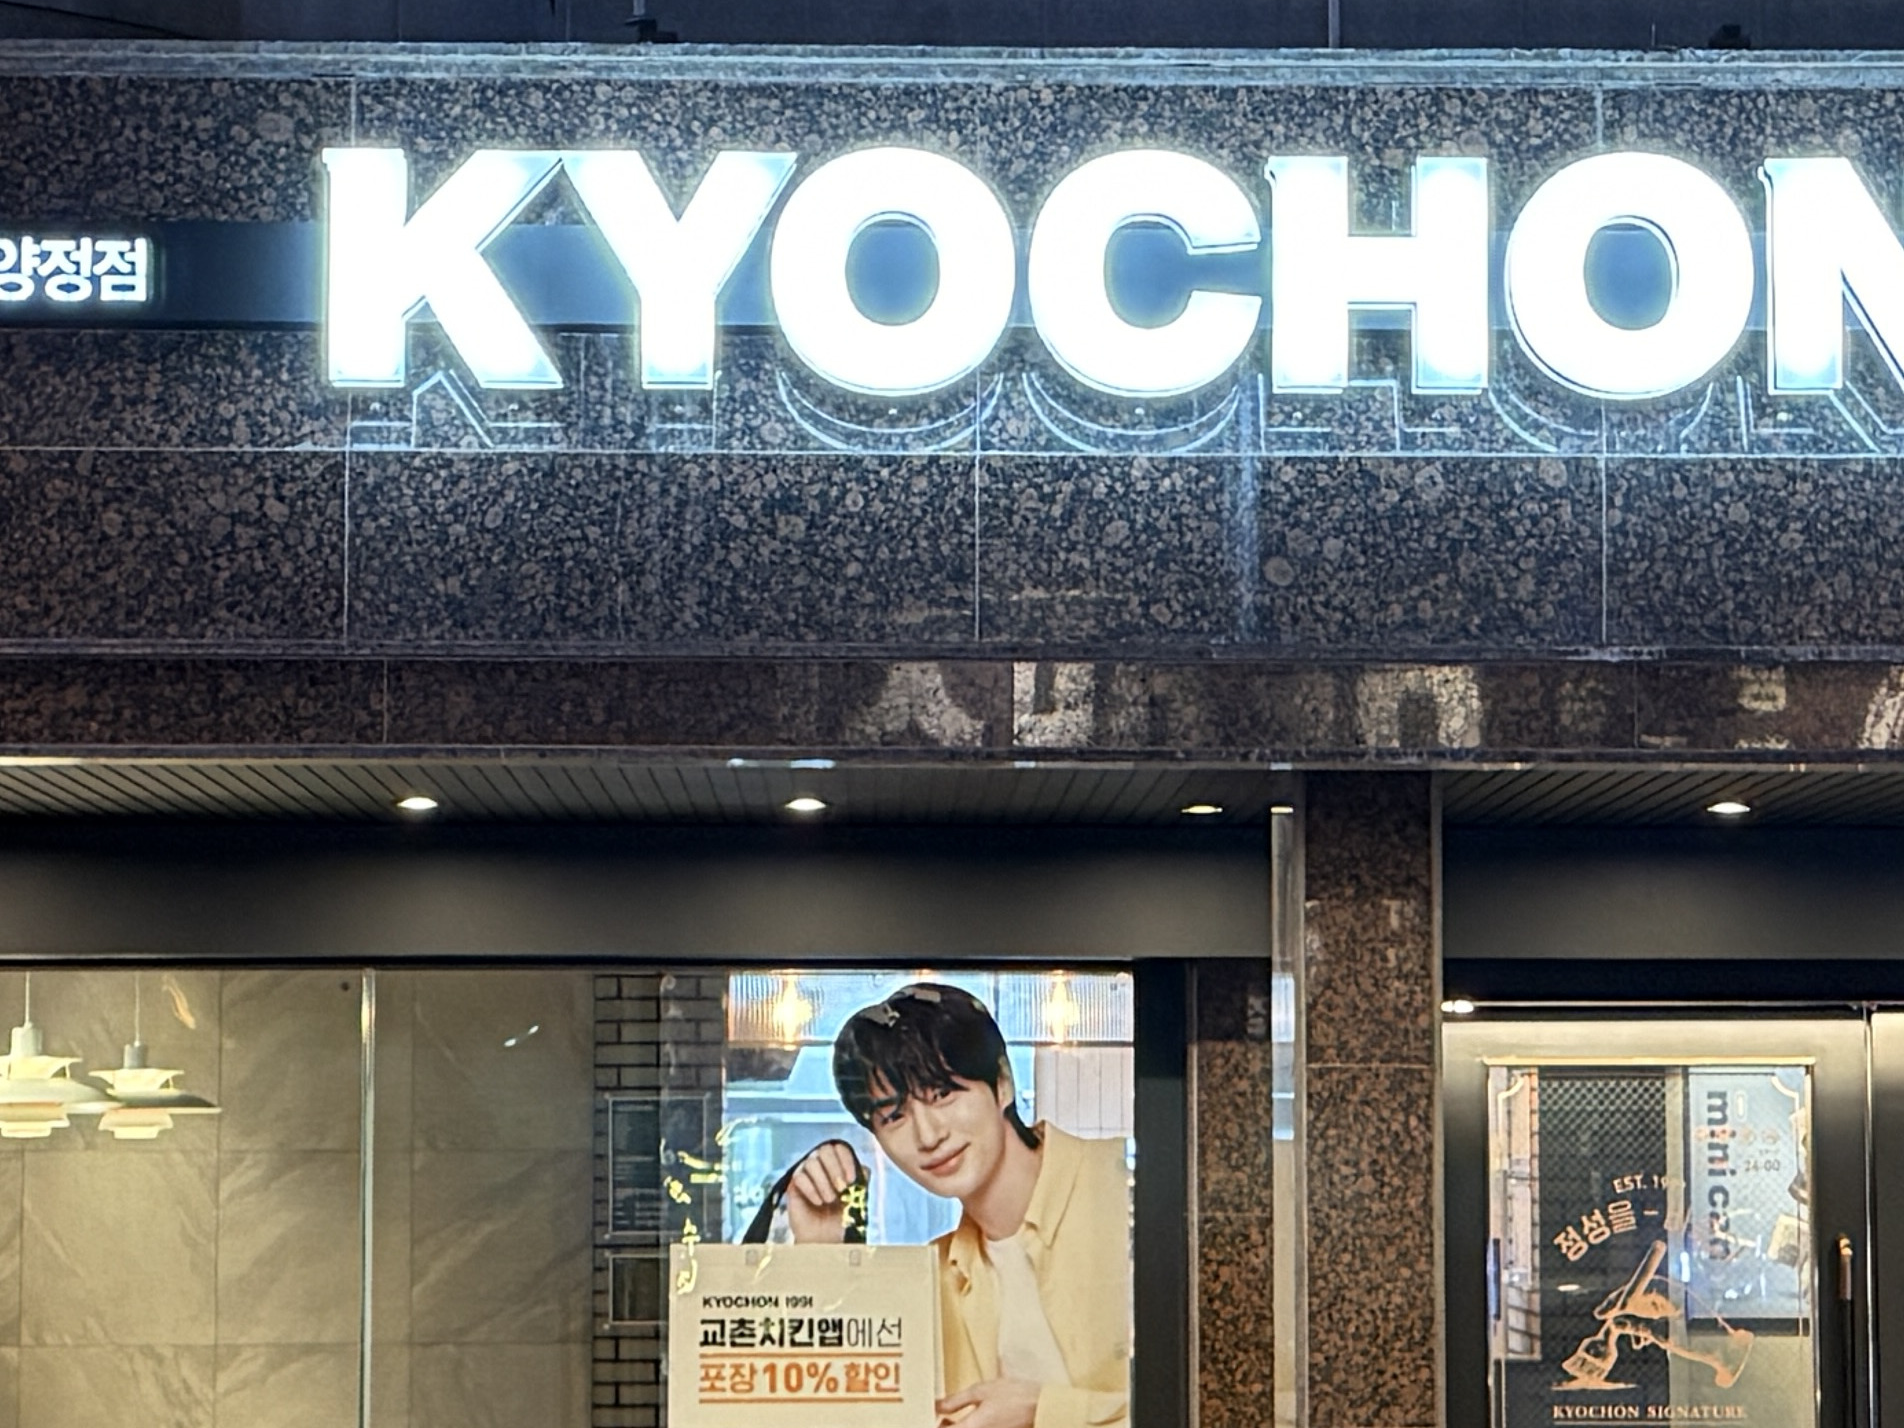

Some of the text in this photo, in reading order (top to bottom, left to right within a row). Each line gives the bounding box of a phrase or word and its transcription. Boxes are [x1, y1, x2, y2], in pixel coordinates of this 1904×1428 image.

[1553, 1199, 1637, 1263] 정성을
[702, 1295, 780, 1309] KYOCHON
[699, 1317, 903, 1349] 교촌치킨앱에선
[699, 1362, 901, 1394] 포장 10% 할인
[1552, 1404, 1746, 1419] KYOCHON SIGNATURE
